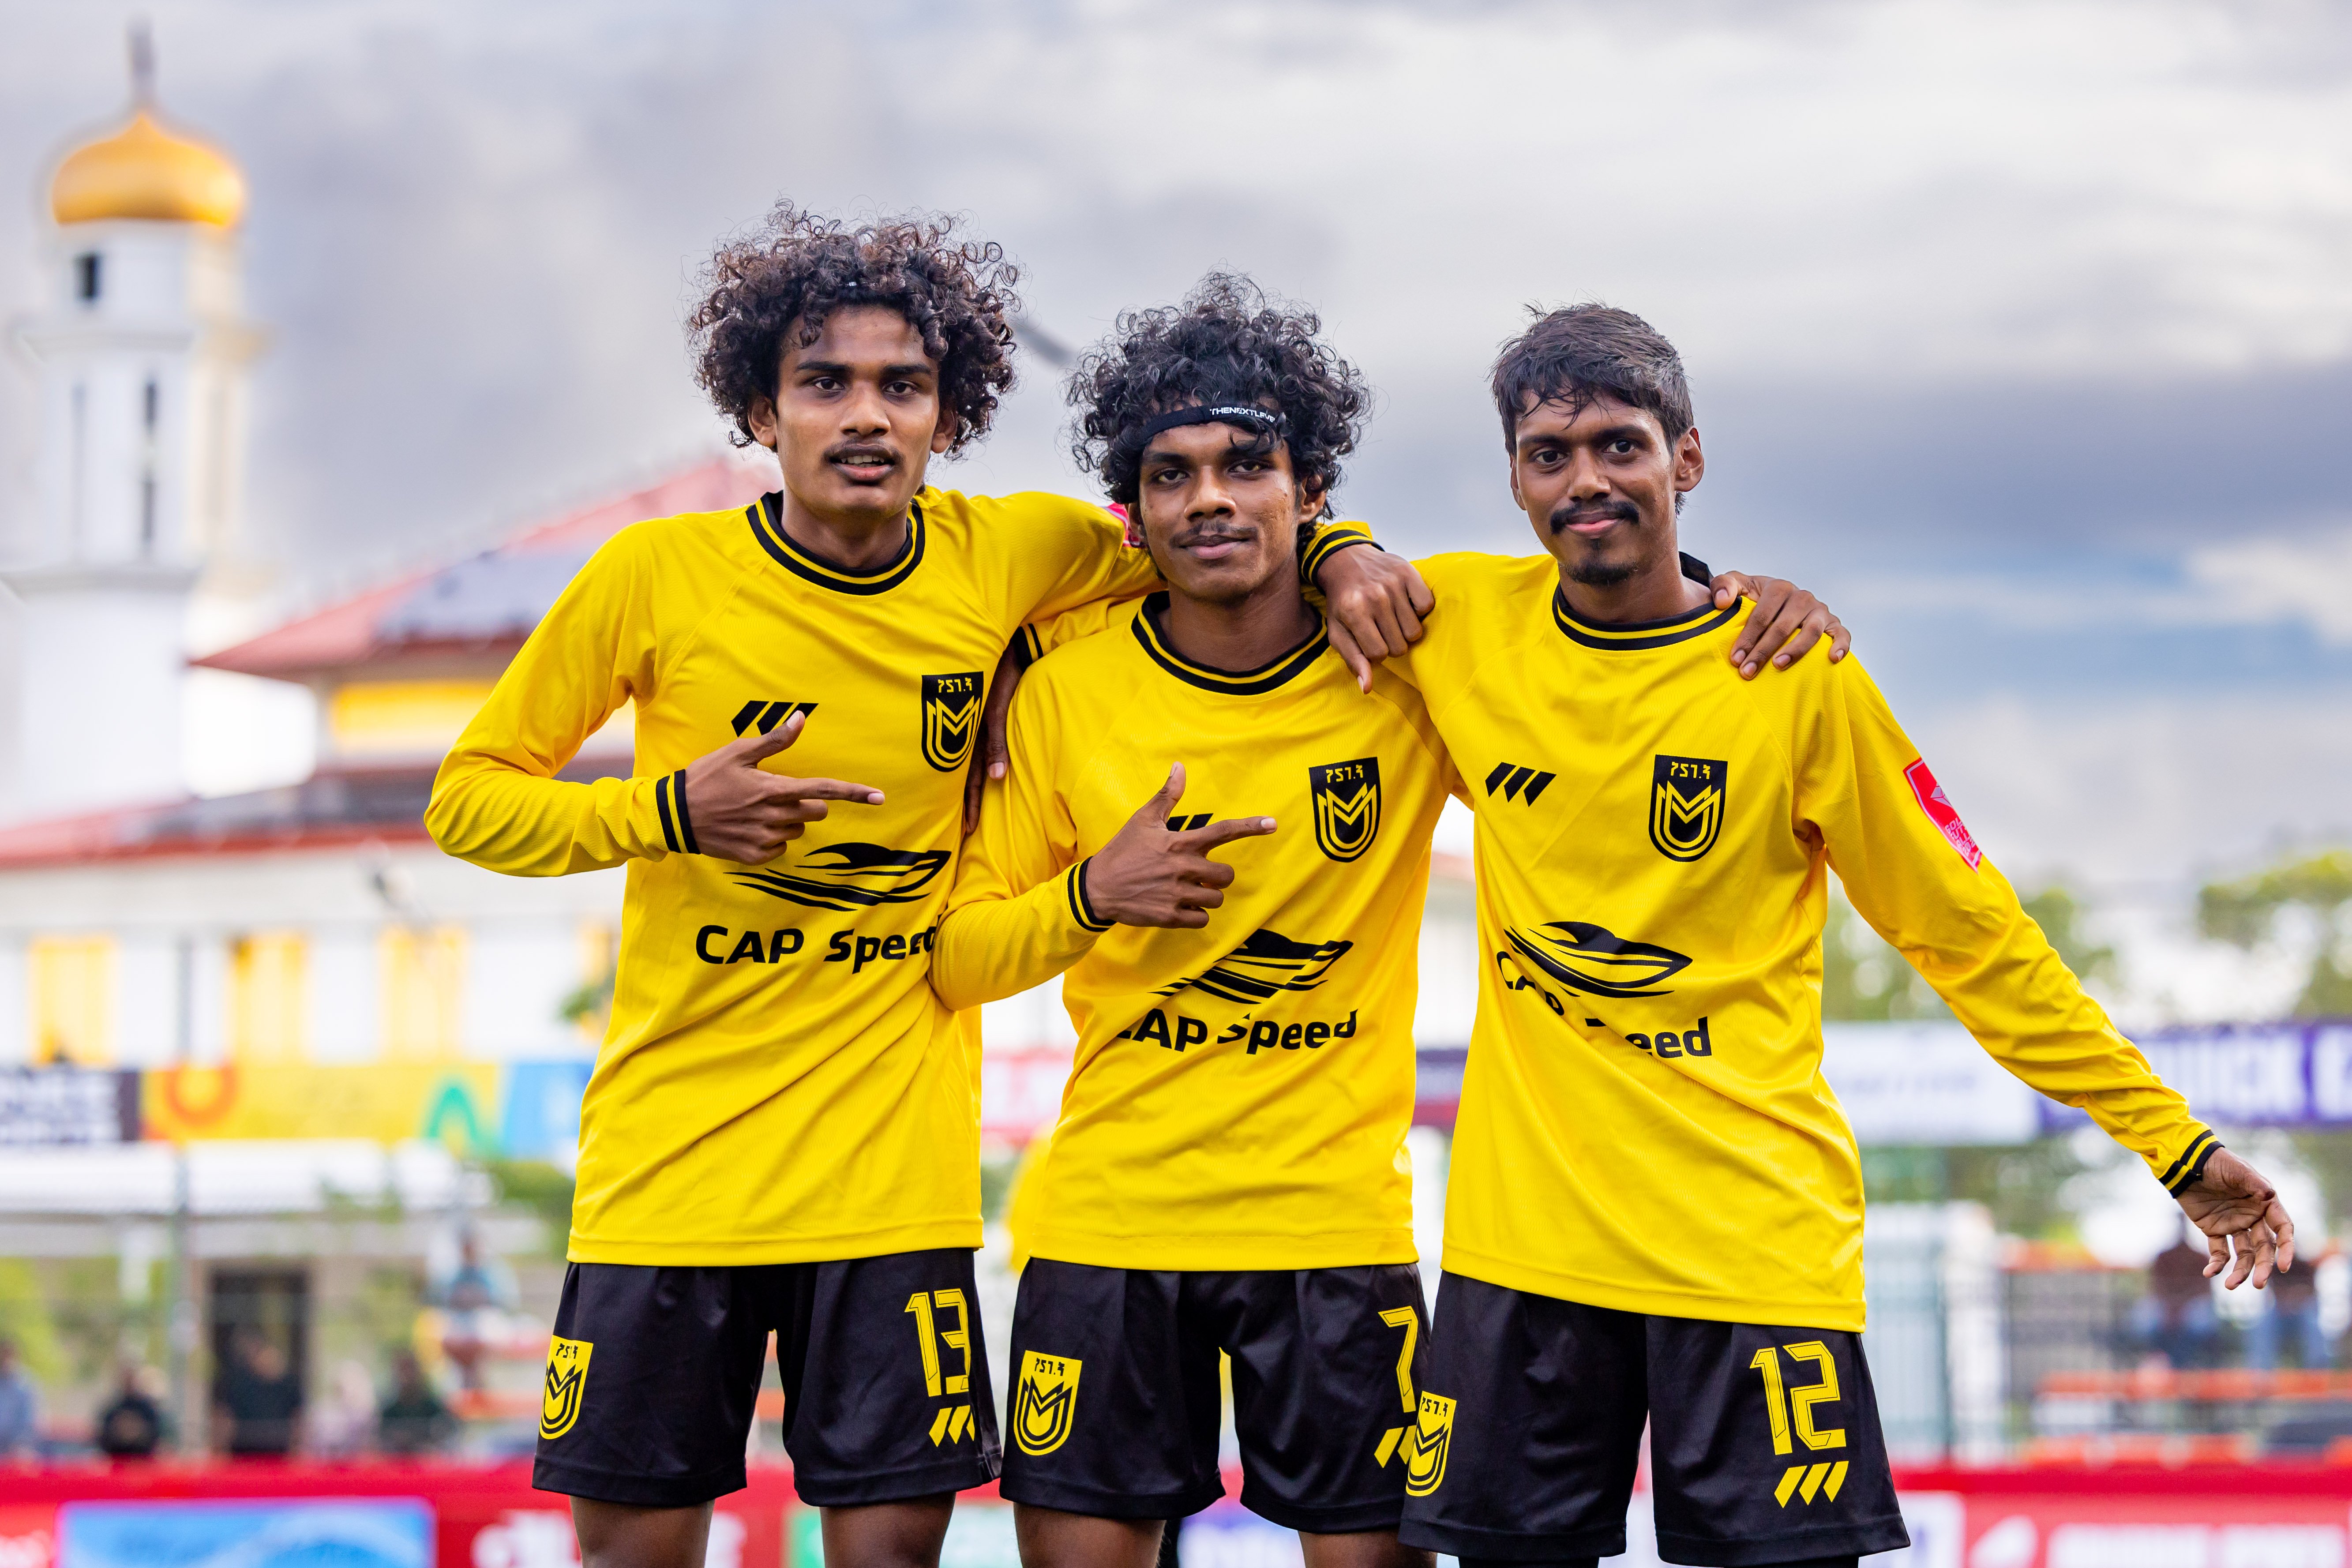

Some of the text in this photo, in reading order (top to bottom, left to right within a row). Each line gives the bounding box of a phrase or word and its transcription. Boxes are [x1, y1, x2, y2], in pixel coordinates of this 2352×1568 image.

[1209, 407, 1275, 423] THENEXTLEVE
[1945, 817, 1962, 834] GOL
[696, 925, 804, 964] CAP
[1116, 1008, 1358, 1055] AP Speed
[1585, 1016, 1712, 1058] eed
[904, 1288, 971, 1397] 13
[1378, 1306, 1418, 1413] 7
[1750, 1341, 1846, 1455] 12
